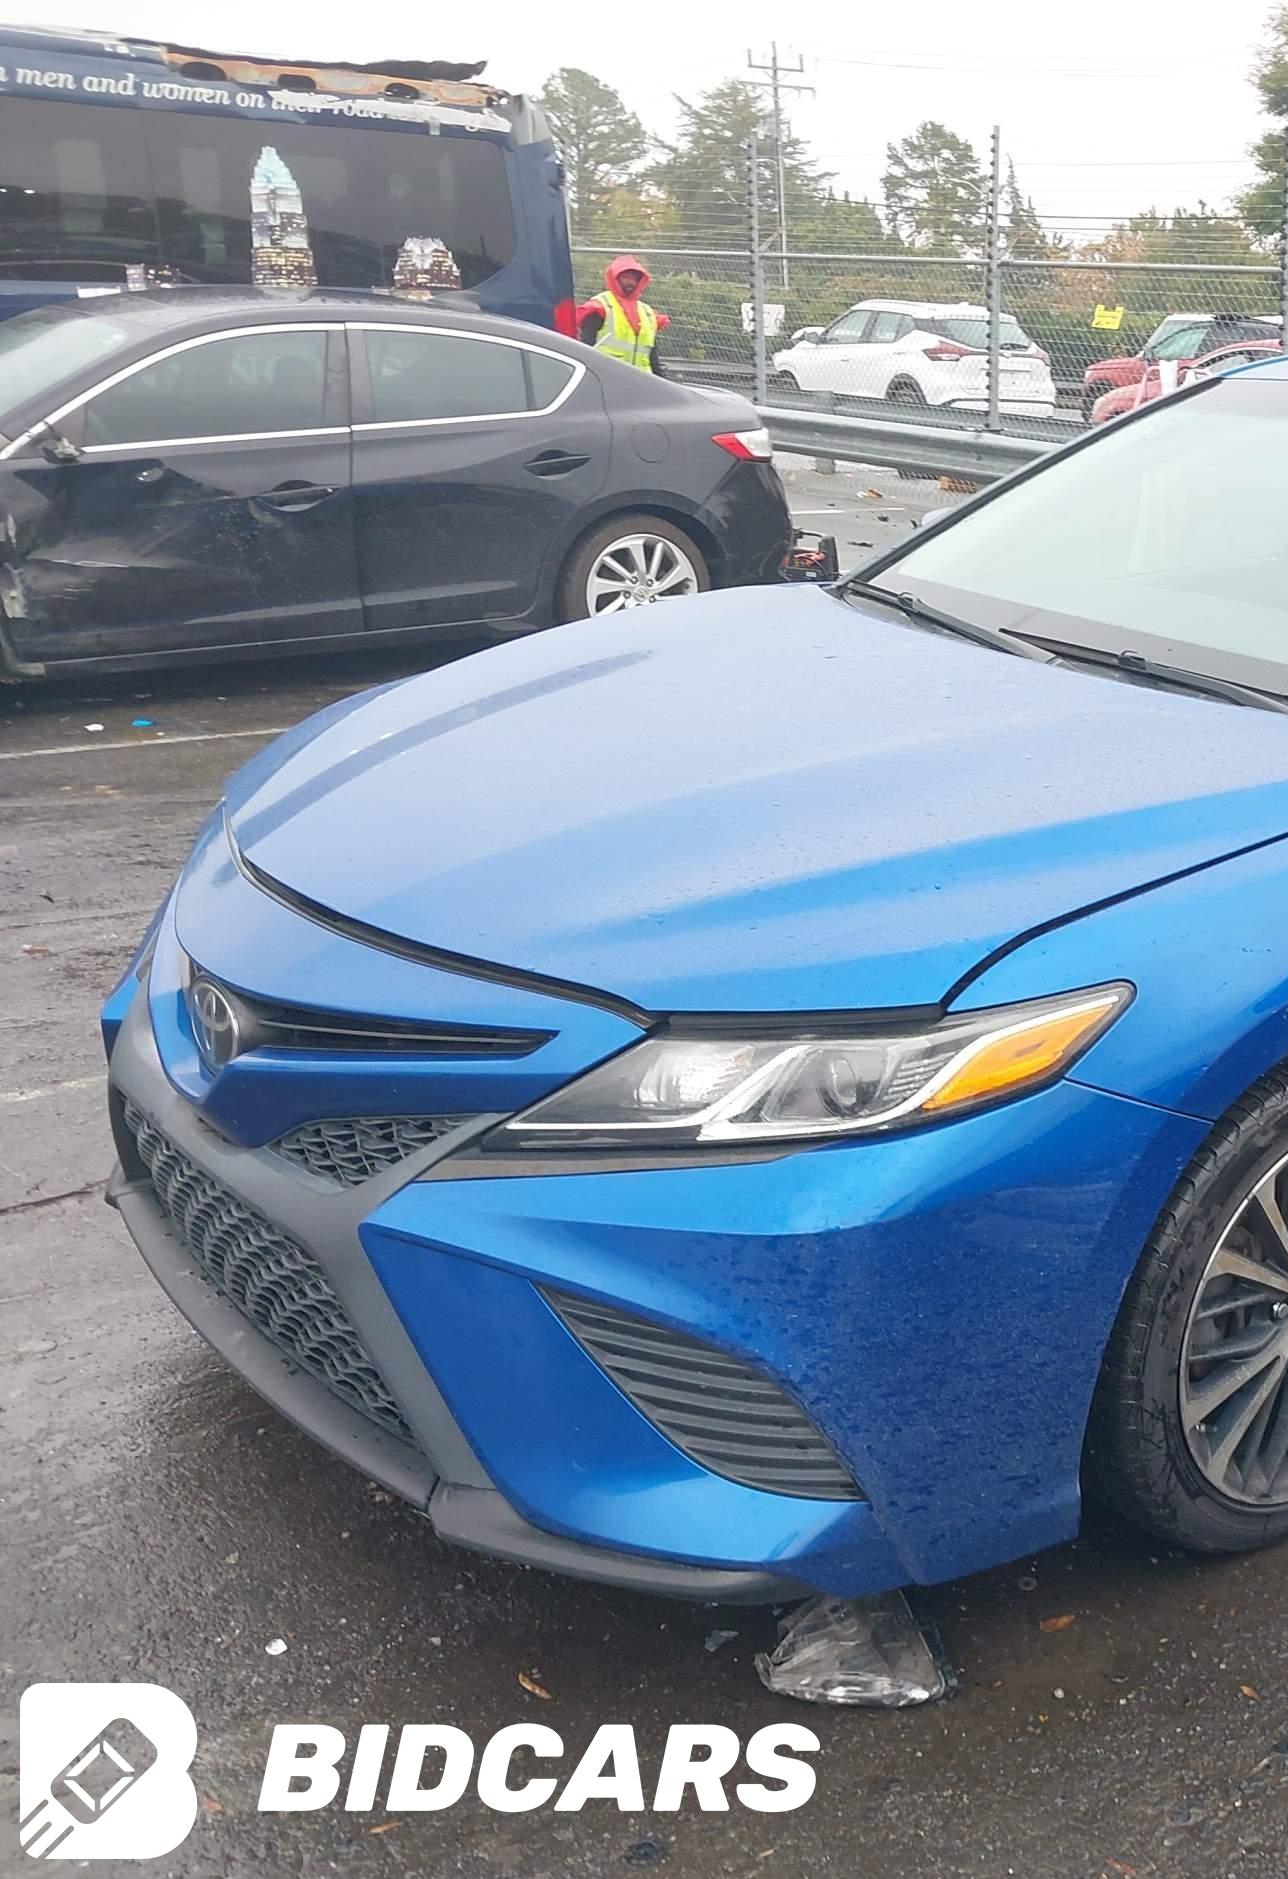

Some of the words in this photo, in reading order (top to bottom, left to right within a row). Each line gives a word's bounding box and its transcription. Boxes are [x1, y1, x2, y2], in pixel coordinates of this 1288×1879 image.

[16, 68, 77, 90] men
[82, 72, 140, 96] and
[142, 81, 231, 105] women
[236, 91, 266, 109] on
